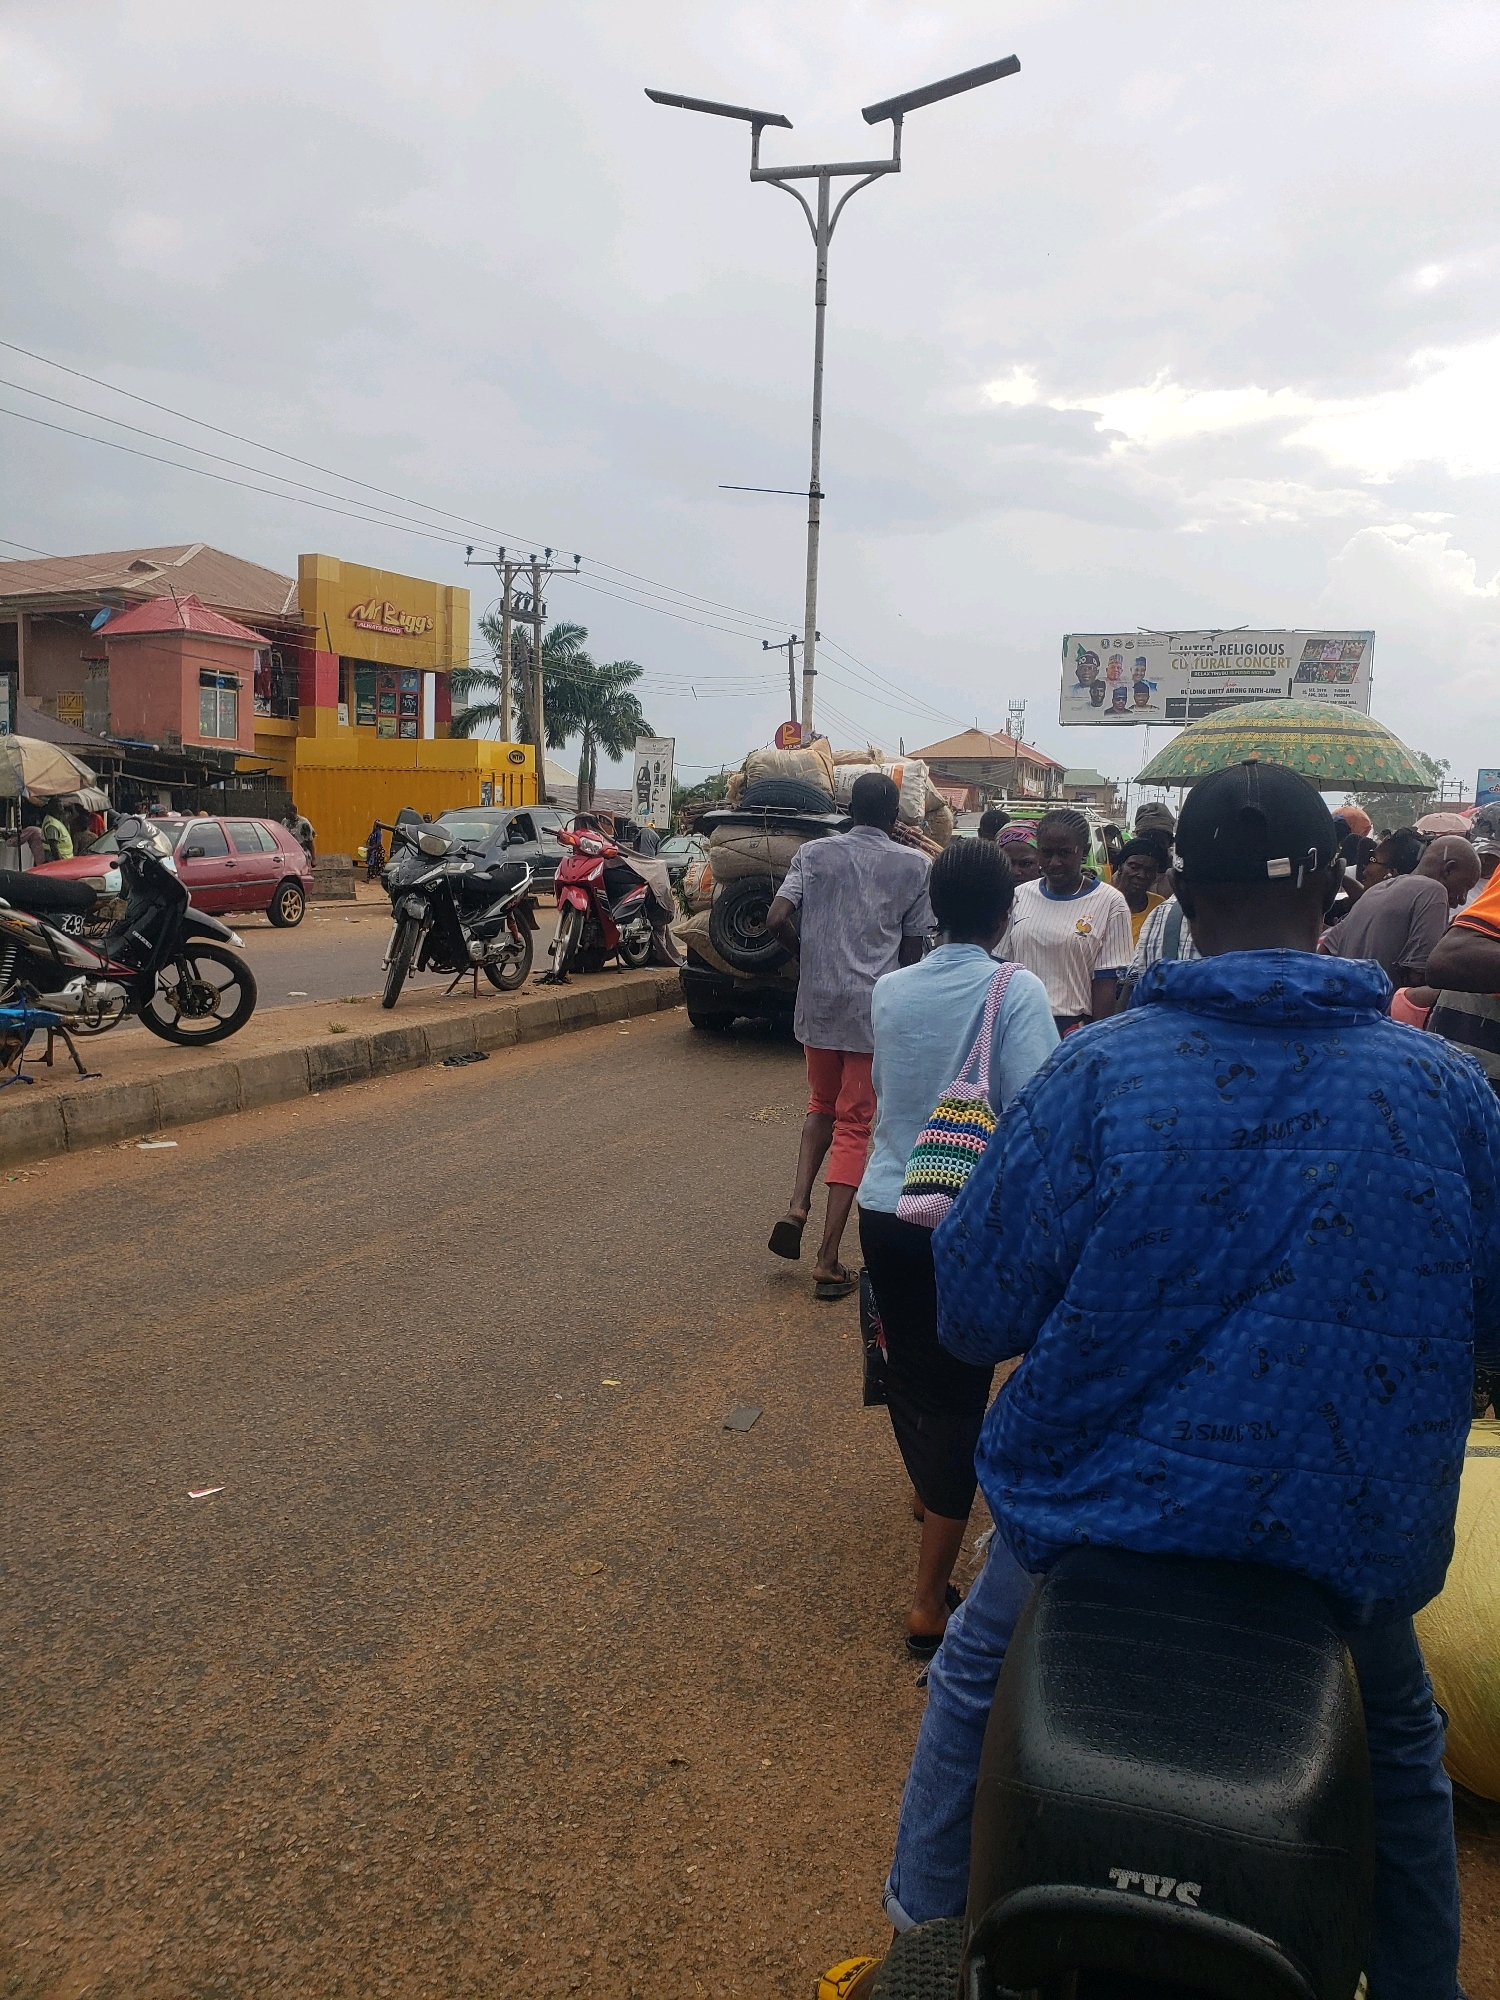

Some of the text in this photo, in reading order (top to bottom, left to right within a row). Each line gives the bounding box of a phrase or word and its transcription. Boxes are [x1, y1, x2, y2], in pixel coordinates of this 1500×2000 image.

[348, 598, 381, 621] Mr
[358, 622, 401, 634] ALWAYS GOOD
[1235, 656, 1292, 669] CONCERT
[1108, 1867, 1202, 1906] TVS
